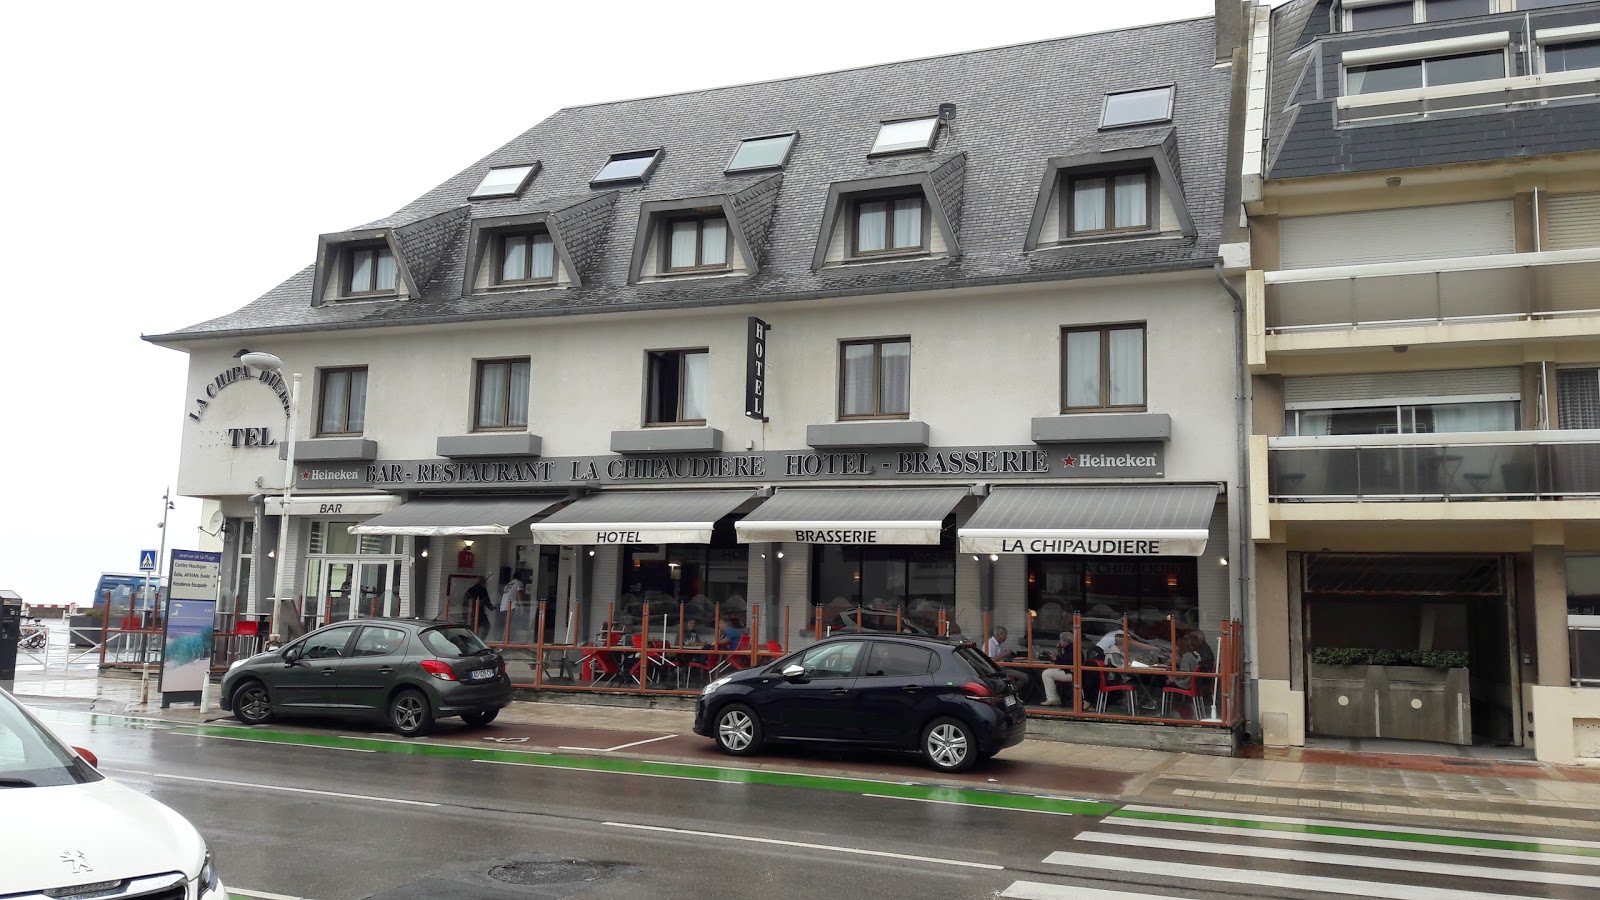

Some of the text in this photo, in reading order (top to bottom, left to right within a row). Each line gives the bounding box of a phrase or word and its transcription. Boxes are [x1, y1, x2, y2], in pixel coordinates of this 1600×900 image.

[754, 322, 764, 414] HOTEL
[189, 398, 208, 422] LA
[311, 469, 358, 480] Heineken
[415, 461, 555, 483] RESTAURANT
[569, 460, 600, 481] LA
[607, 455, 766, 479] CHIPAUDIERE
[784, 453, 874, 476] HOTEL
[896, 450, 1049, 474] BRASSERIE
[1079, 454, 1156, 467] Heineken
[319, 503, 343, 514] BAR
[597, 531, 642, 543] HOTEL
[795, 530, 877, 543] BRASSERIE
[1002, 539, 1160, 554] LA CHIPAUDIERE
